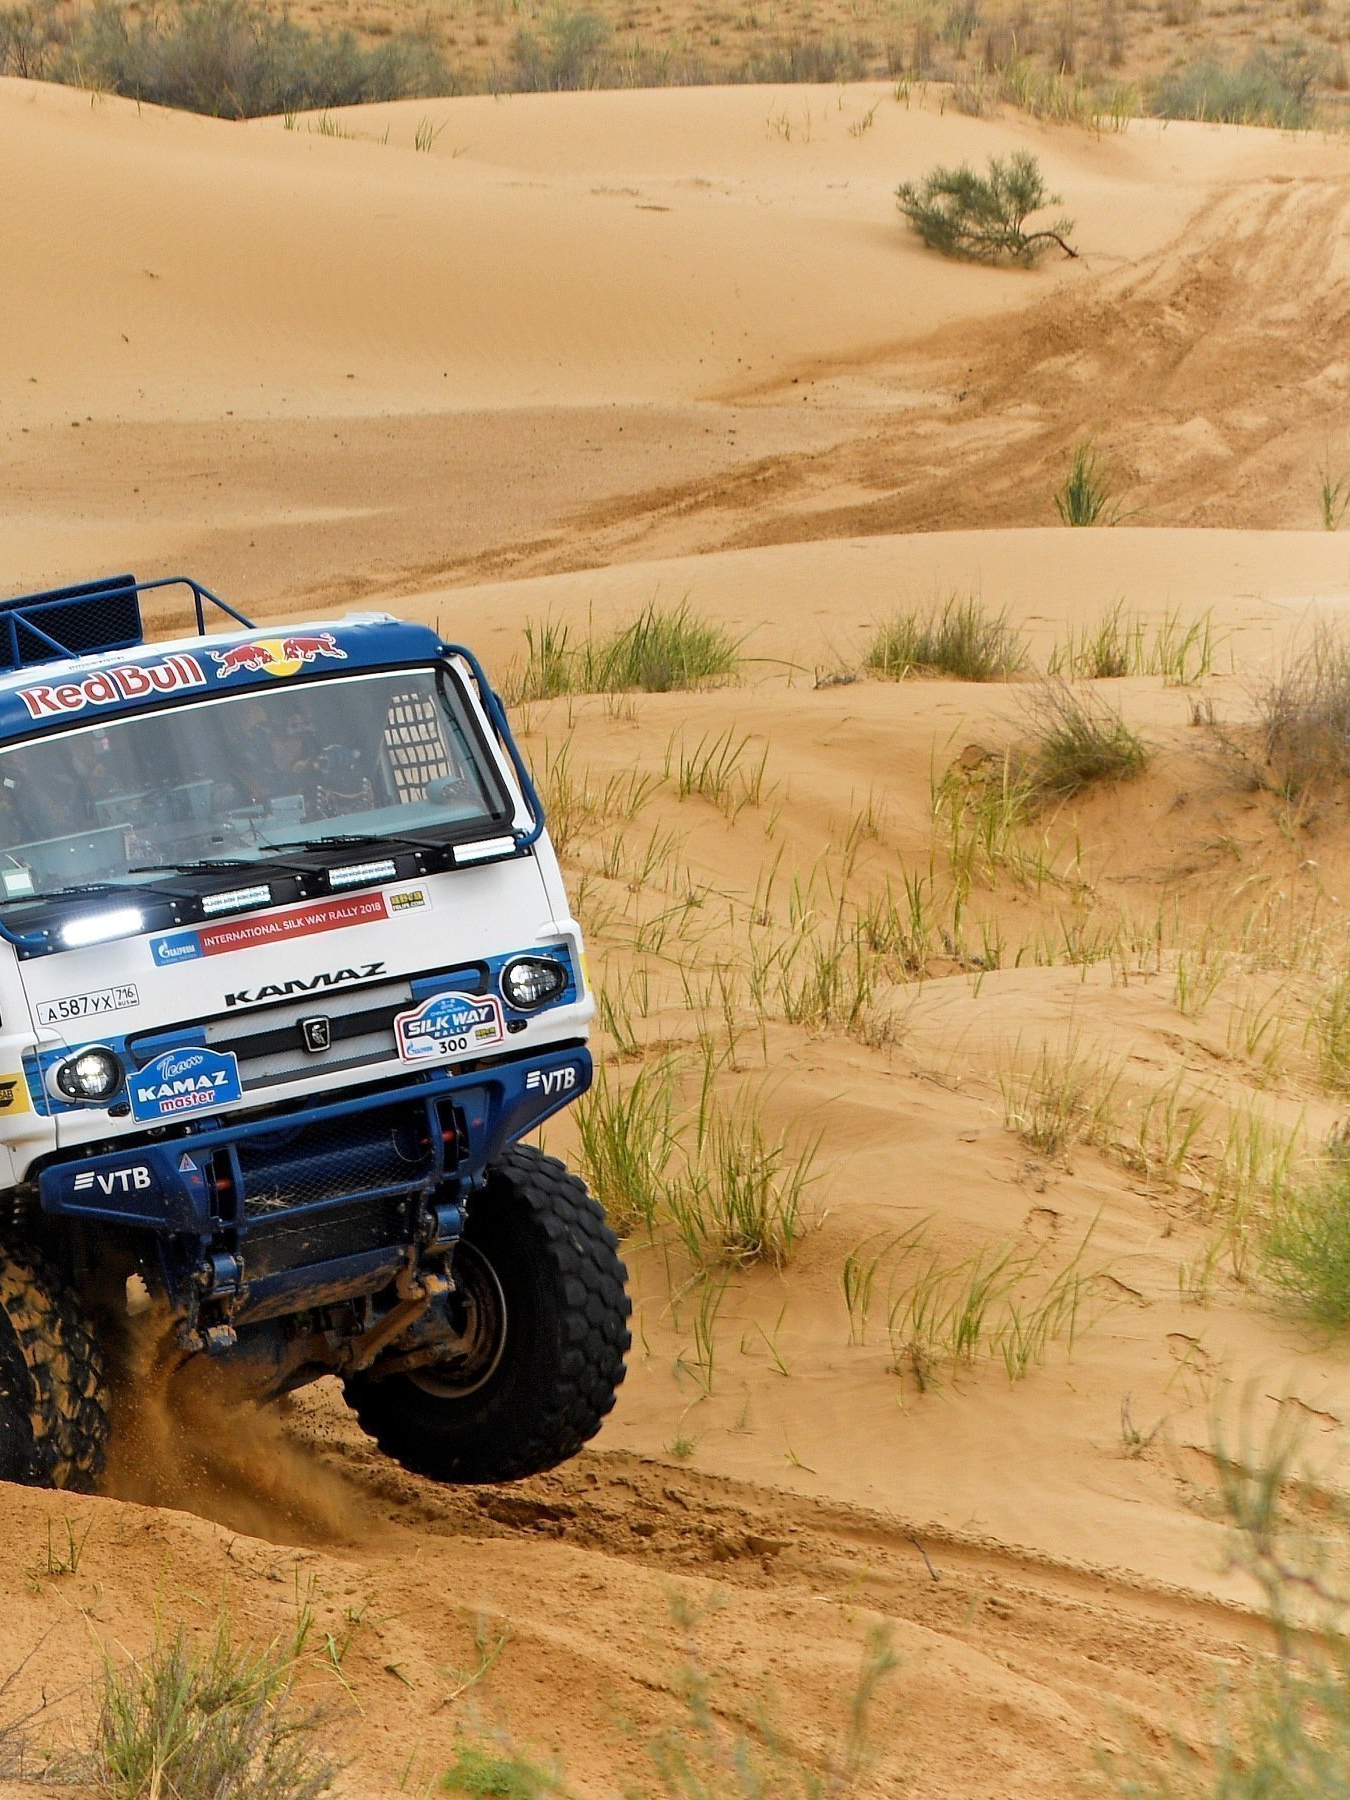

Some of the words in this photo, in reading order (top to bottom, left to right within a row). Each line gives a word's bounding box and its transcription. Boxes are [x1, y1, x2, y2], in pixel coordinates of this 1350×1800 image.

[203, 923, 282, 947] INTERNATIONAL
[283, 918, 305, 930] SILK
[305, 913, 327, 925] WAY
[329, 908, 359, 920] RALLY
[360, 902, 382, 914] 2018
[115, 987, 134, 1000] 716
[224, 961, 387, 1007] KAMAZ
[407, 1014, 450, 1037] SILK
[451, 1006, 491, 1027] WAY
[434, 1025, 468, 1039] RALLY
[438, 1037, 468, 1054] 300
[156, 1055, 204, 1080] Team
[541, 1066, 576, 1096] VTB
[137, 1070, 229, 1103] KAMAZ
[159, 1089, 216, 1113] master
[96, 1166, 151, 1195] VTB
